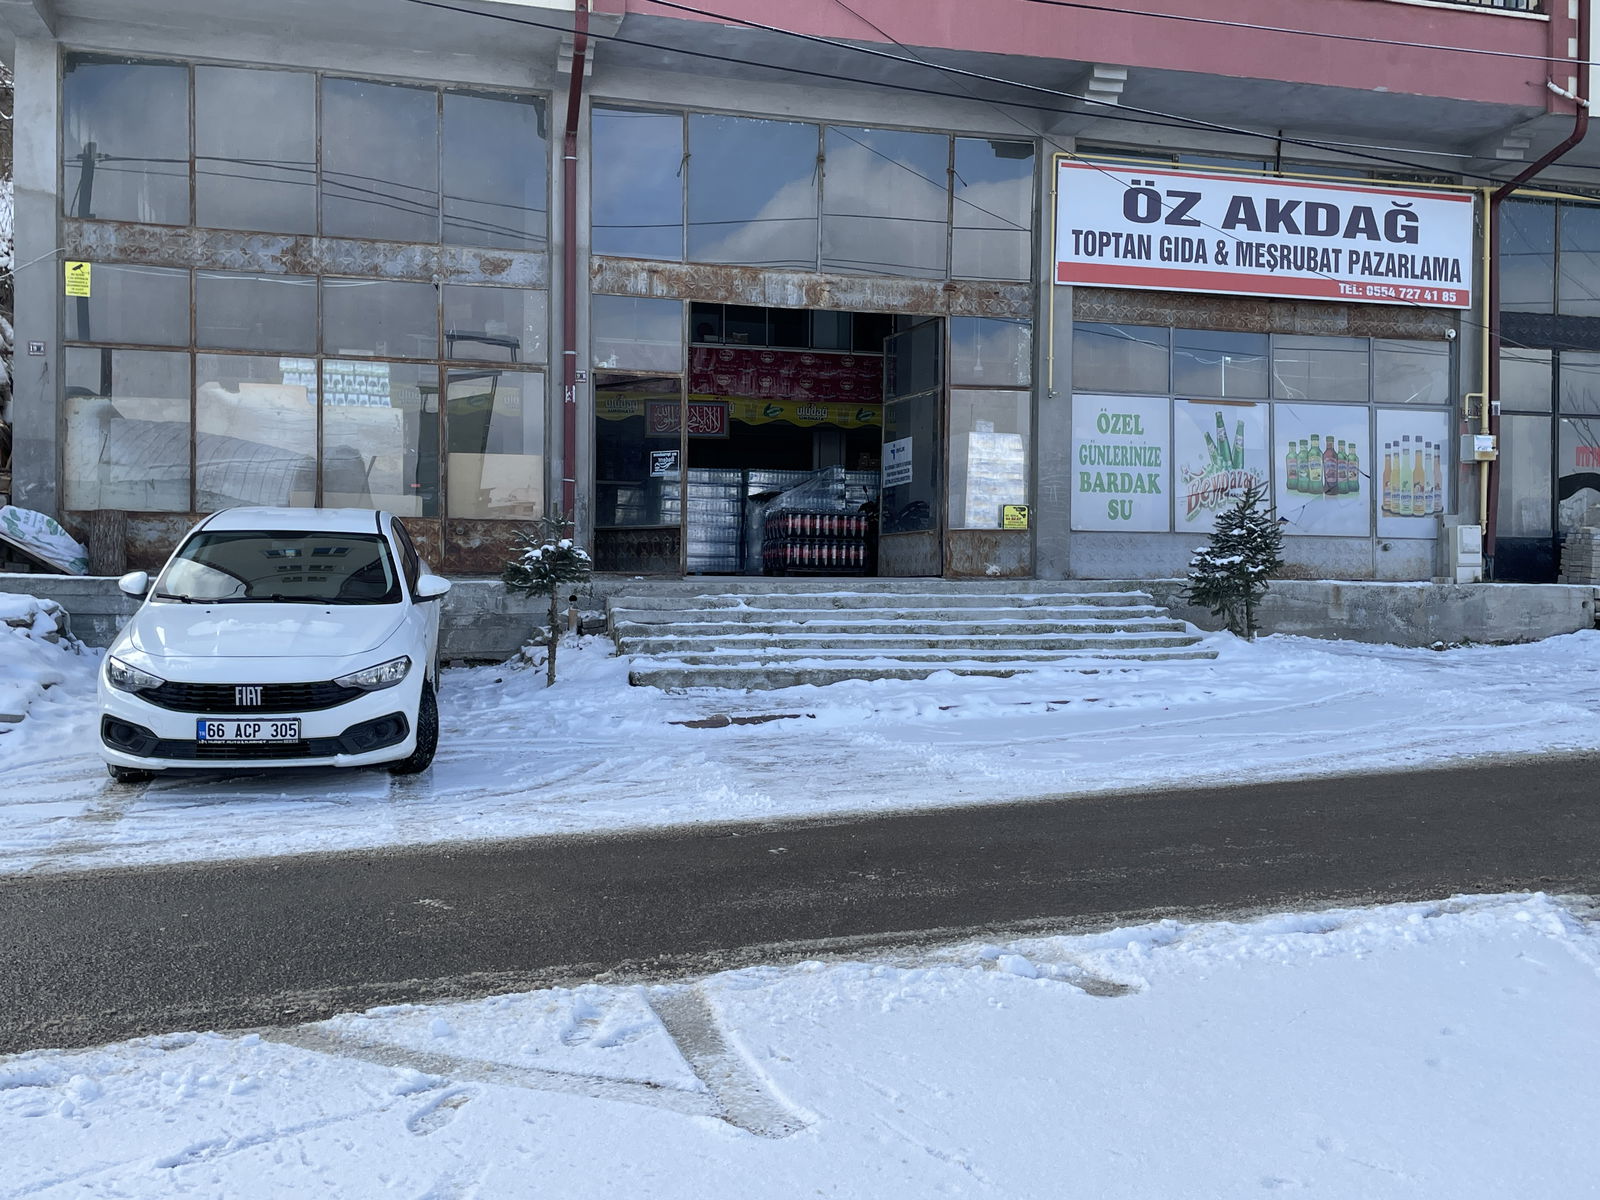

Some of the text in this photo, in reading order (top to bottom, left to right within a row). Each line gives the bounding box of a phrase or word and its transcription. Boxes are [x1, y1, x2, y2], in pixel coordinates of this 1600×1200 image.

[1123, 179, 1420, 245] ÖZ AKDAĞ
[1071, 228, 1462, 284] TOPTAN GIDA & MEŞRUBAT PAZARLAMA
[1338, 282, 1457, 304] TEL: 0554 727 41 85
[1096, 407, 1145, 436] ÖZEL
[1078, 438, 1162, 468] GÜNLERİNİZE
[1079, 471, 1162, 495] BARDAK
[1107, 498, 1134, 521] SU
[235, 686, 263, 706] FIAT
[207, 723, 297, 738] 66 ACP 305
